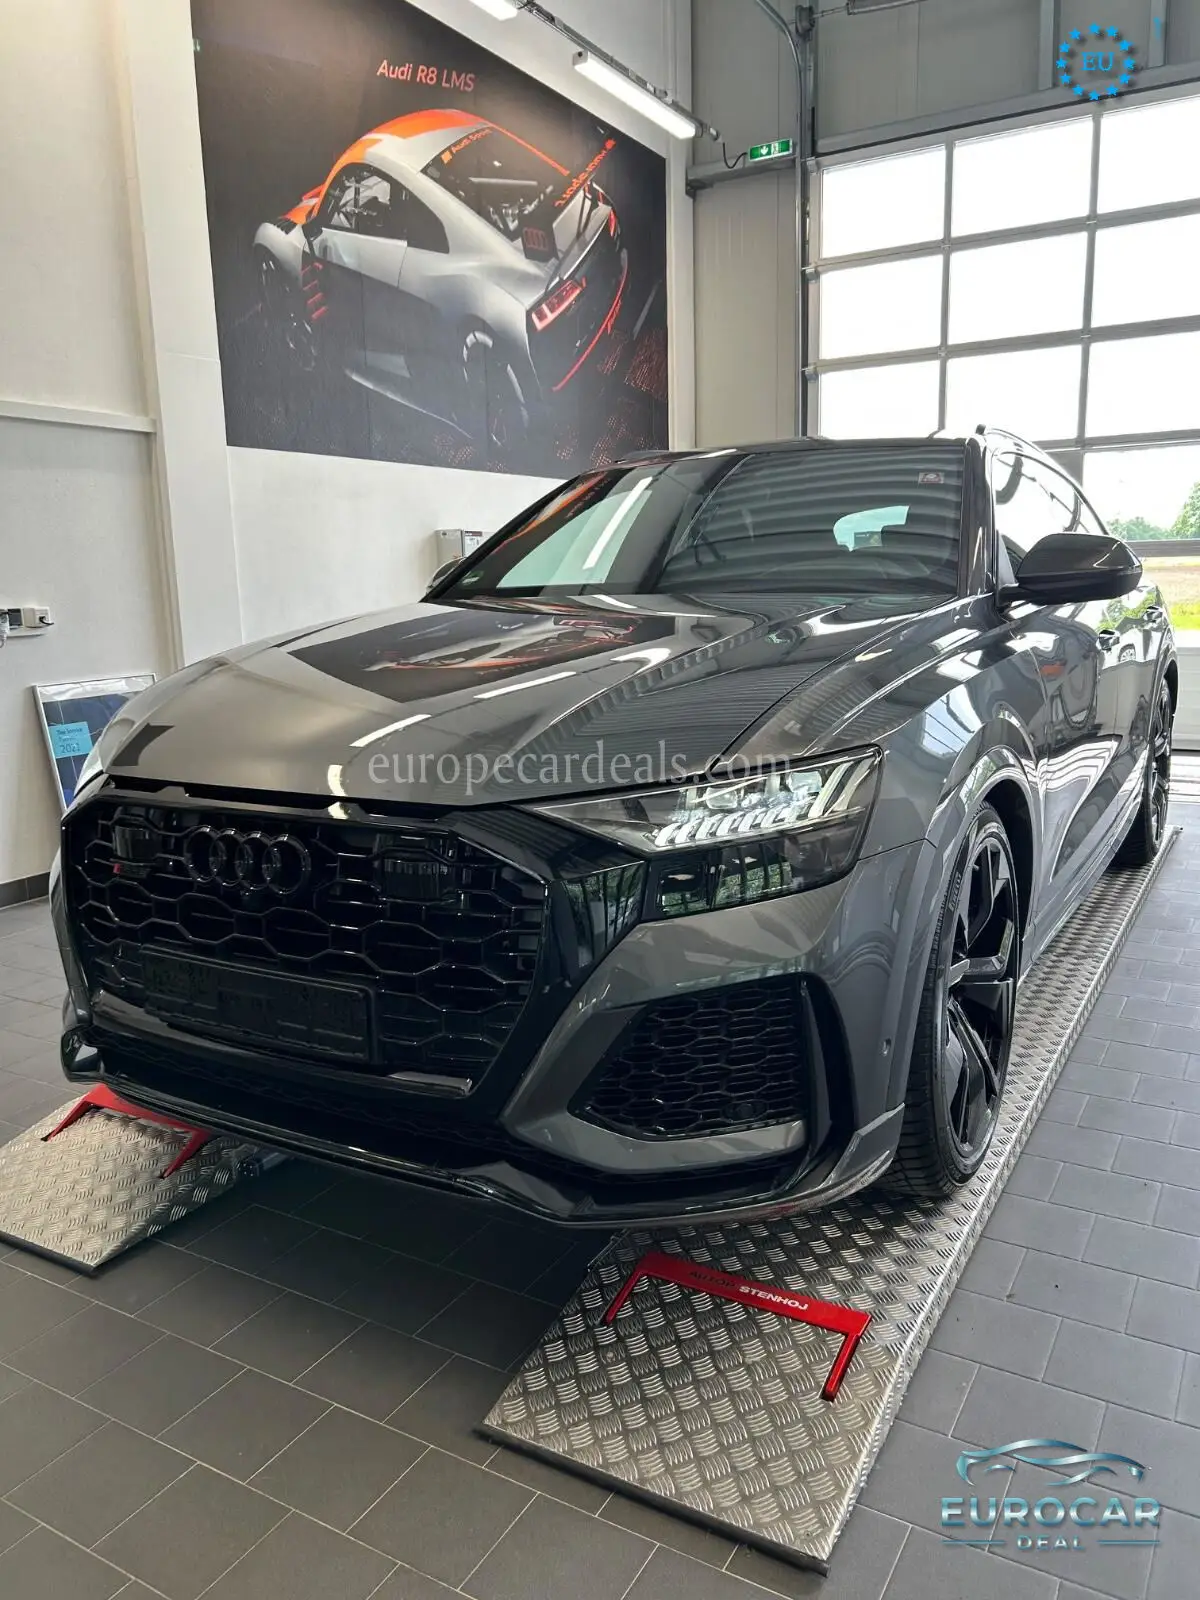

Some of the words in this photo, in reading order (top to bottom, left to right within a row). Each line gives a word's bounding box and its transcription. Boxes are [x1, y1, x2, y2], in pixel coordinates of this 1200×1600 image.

[376, 59, 413, 81] Audi
[416, 64, 438, 85] R8
[441, 69, 476, 92] LMS
[739, 1285, 809, 1311] STENHOJ
